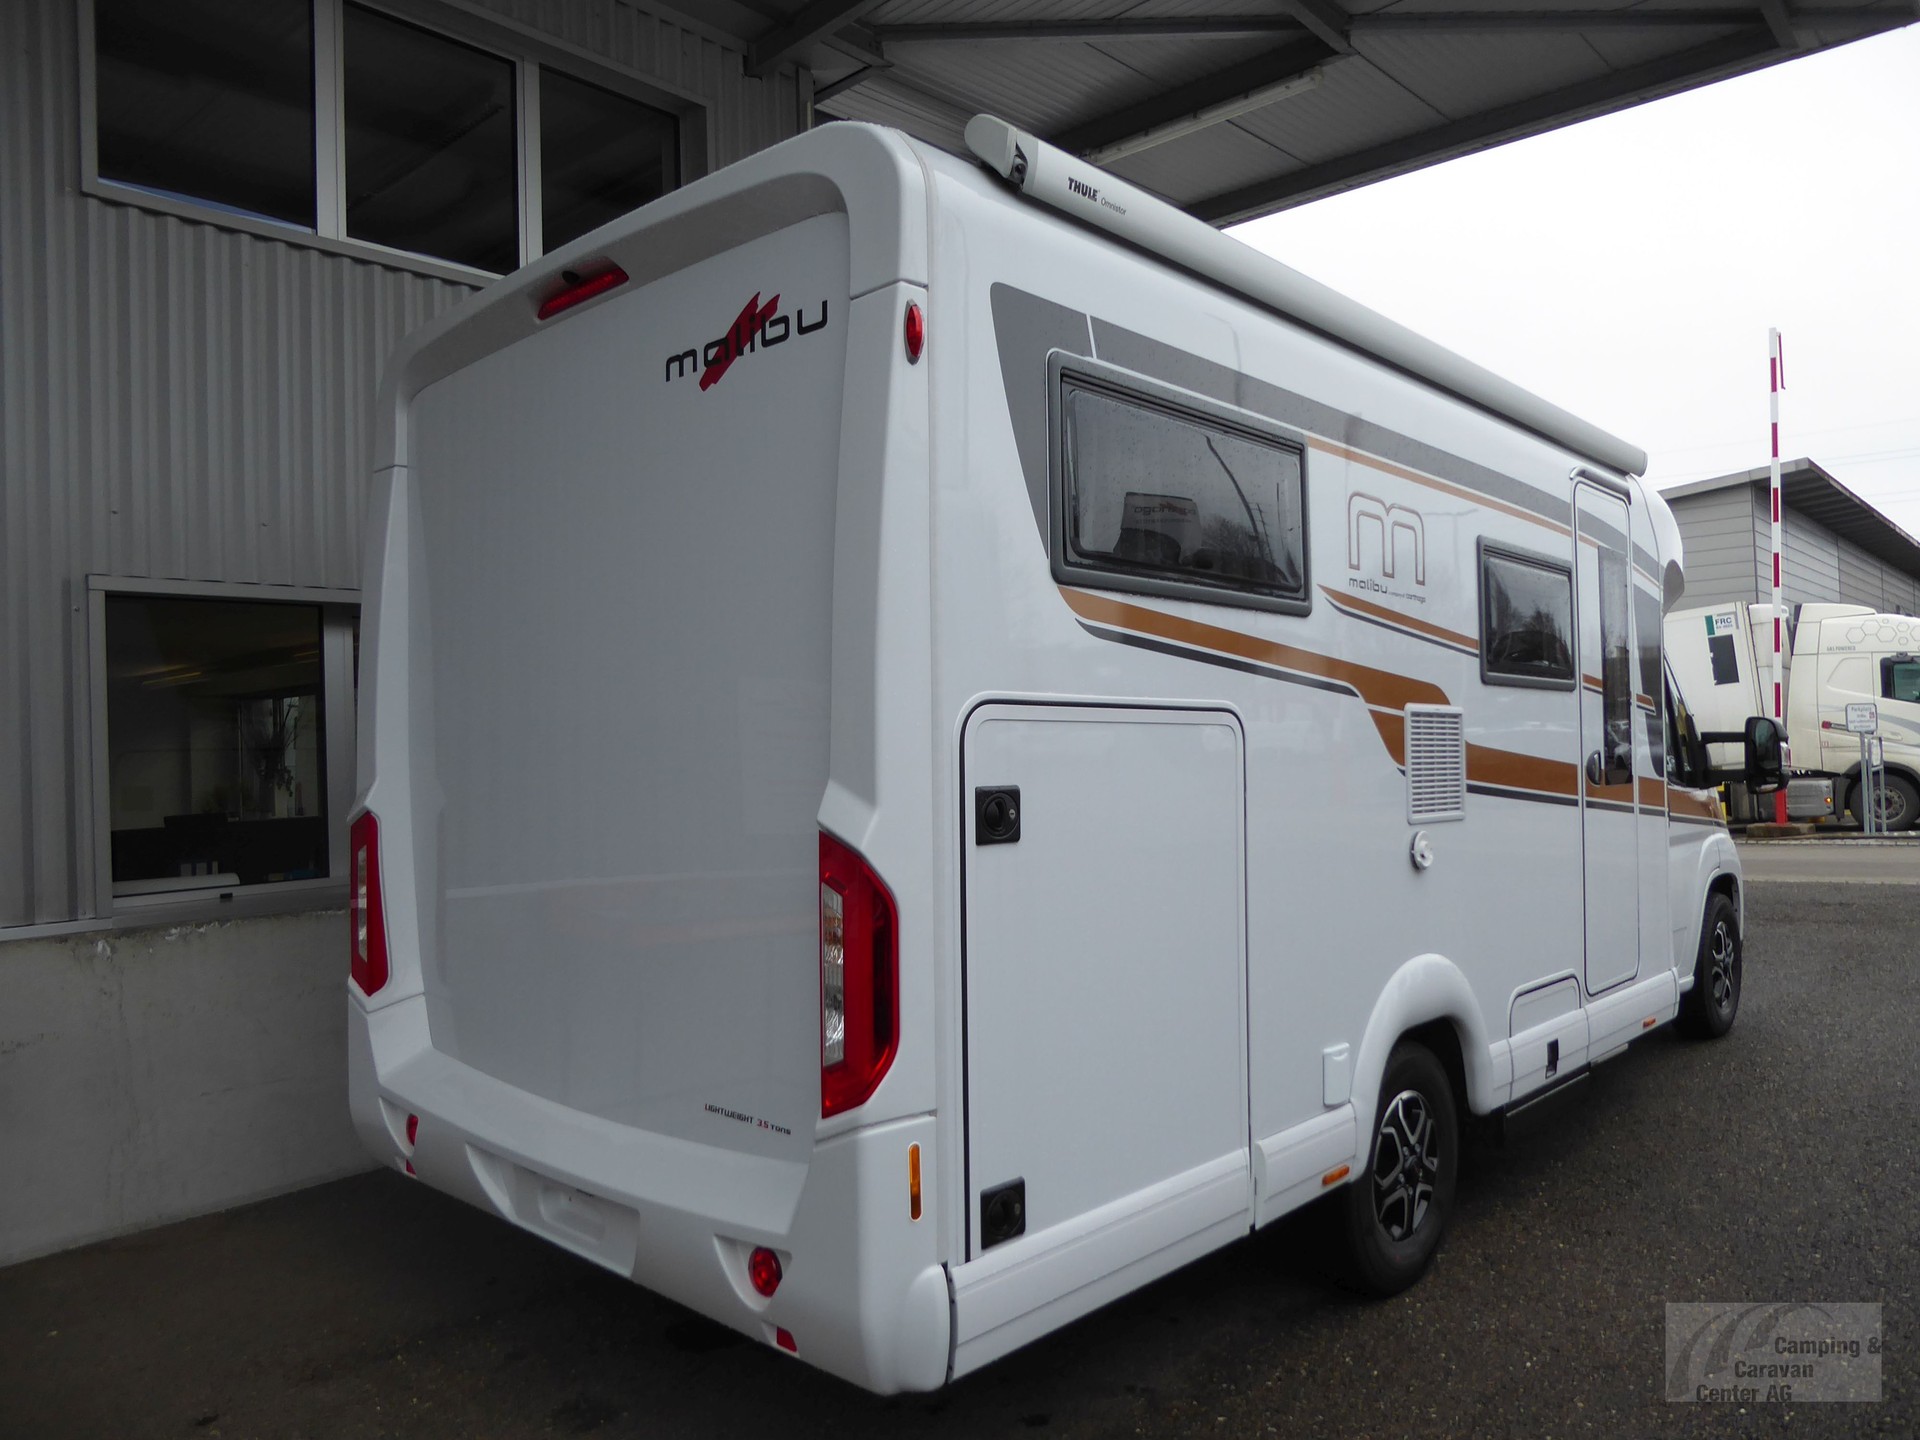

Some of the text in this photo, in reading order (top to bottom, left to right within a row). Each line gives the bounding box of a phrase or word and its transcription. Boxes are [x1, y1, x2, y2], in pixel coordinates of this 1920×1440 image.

[1068, 176, 1098, 202] THULE
[665, 299, 828, 383] malibu
[1348, 577, 1388, 594] malibu
[1715, 617, 1732, 625] FRC
[704, 1103, 754, 1124] LIGHTWEIGHT
